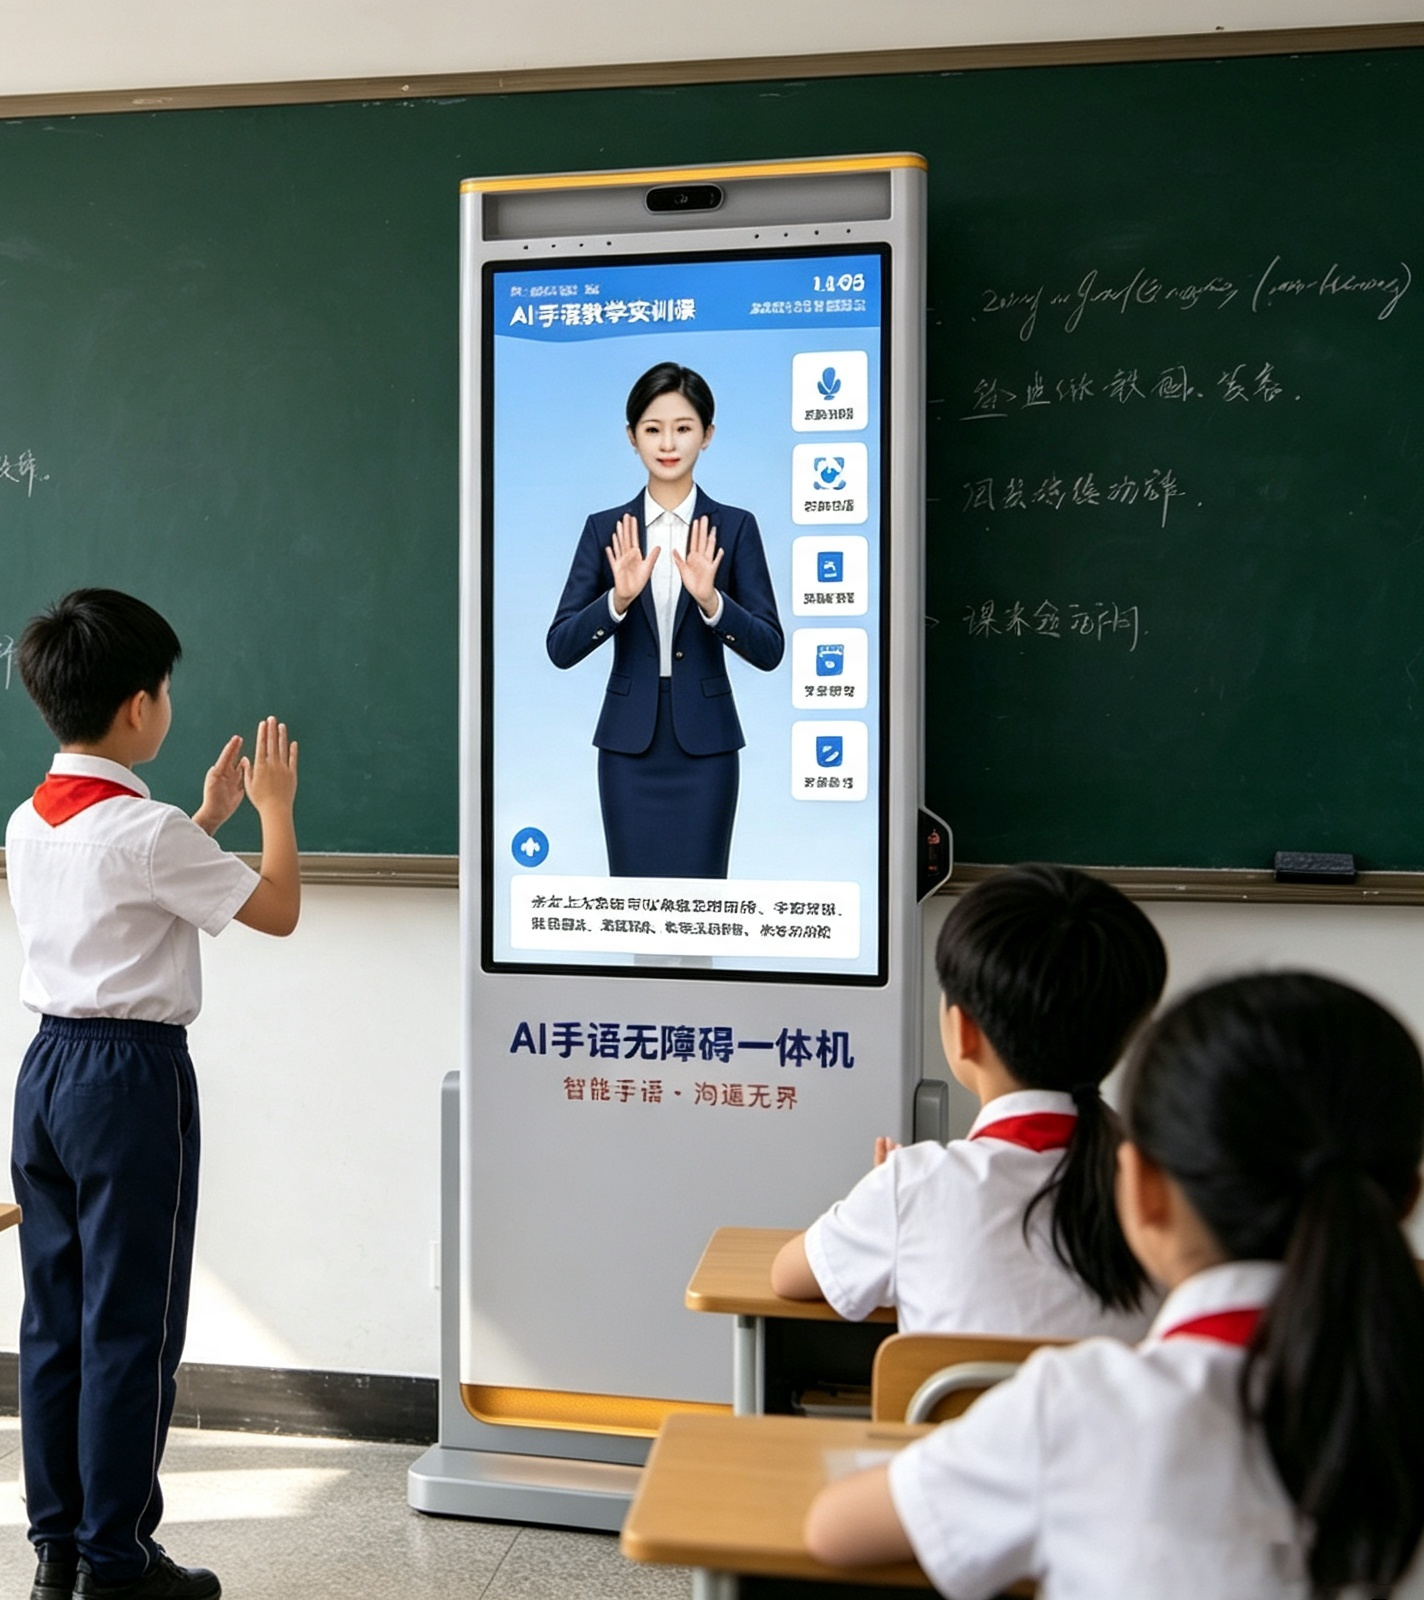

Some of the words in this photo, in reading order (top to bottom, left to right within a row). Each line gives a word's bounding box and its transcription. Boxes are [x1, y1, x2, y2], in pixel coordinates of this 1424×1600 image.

[509, 1021, 855, 1069] AI手语无障碍一体机
